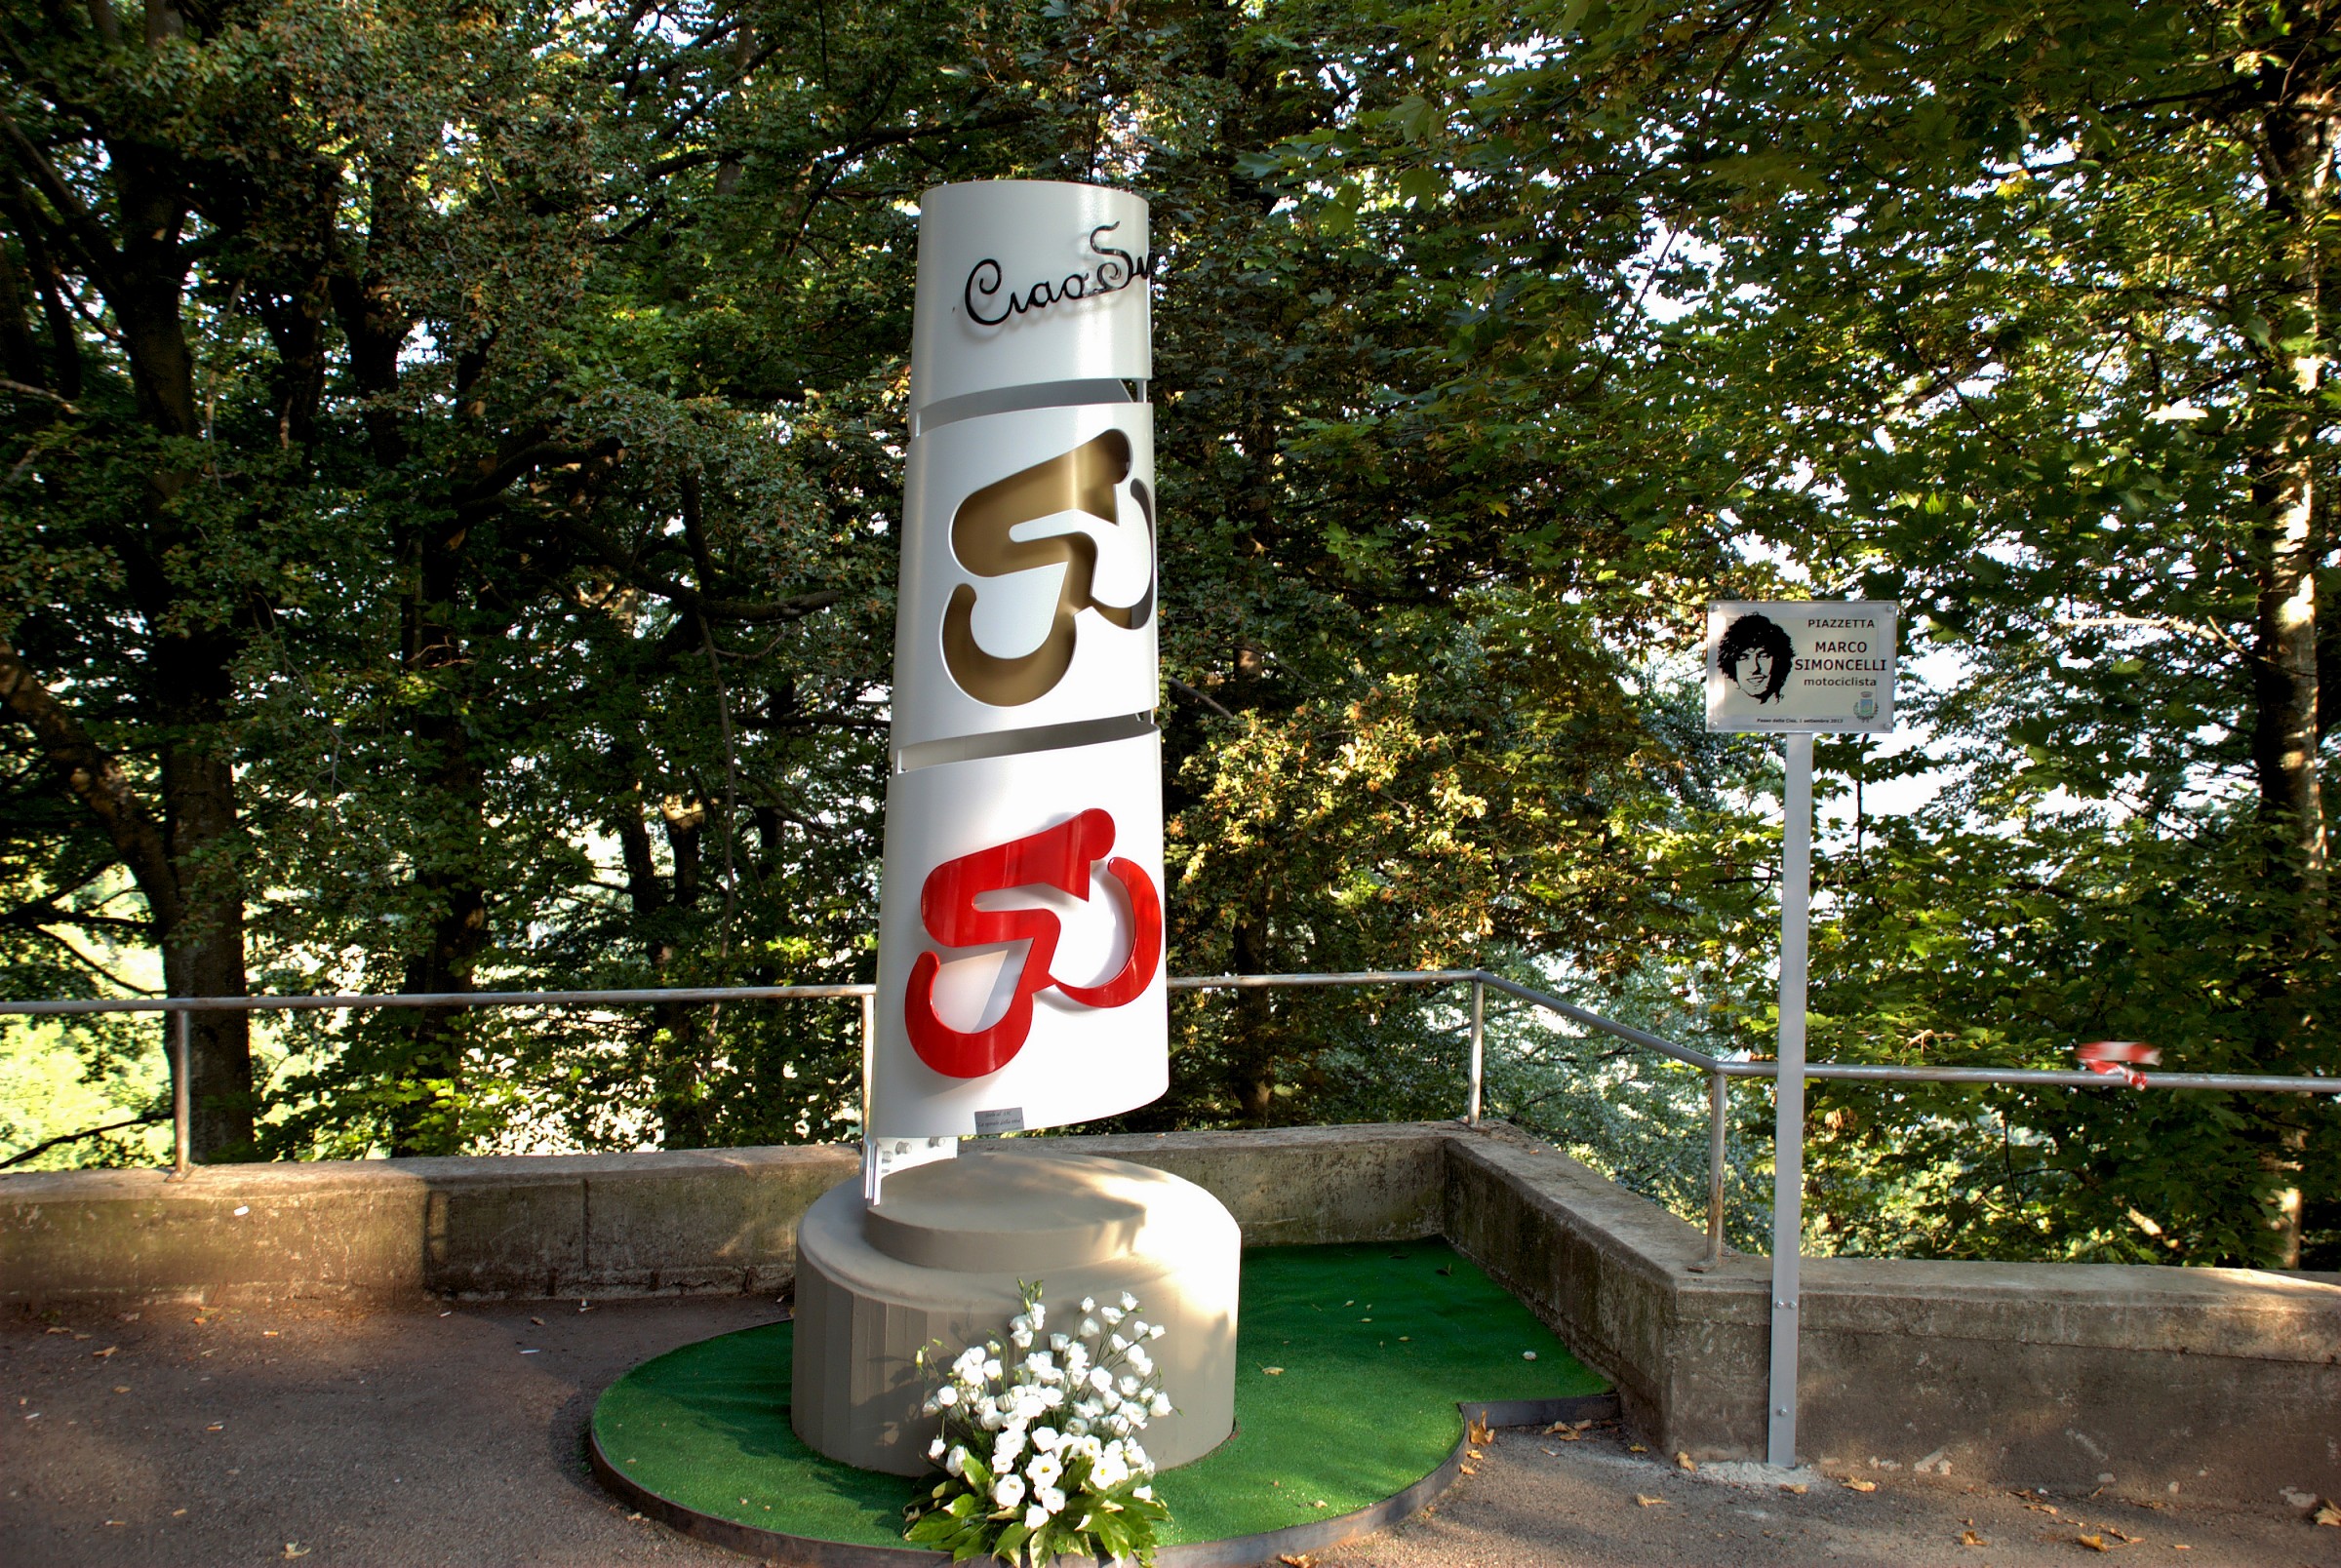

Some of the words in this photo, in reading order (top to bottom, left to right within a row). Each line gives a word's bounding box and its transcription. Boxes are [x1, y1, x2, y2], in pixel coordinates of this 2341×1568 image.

[964, 258, 1090, 327] Ciao
[1807, 619, 1875, 628] PIAZZETTA
[1814, 642, 1867, 652] MARCO
[1794, 659, 1886, 671] SIMONCELLI
[1804, 677, 1877, 686] motociclista
